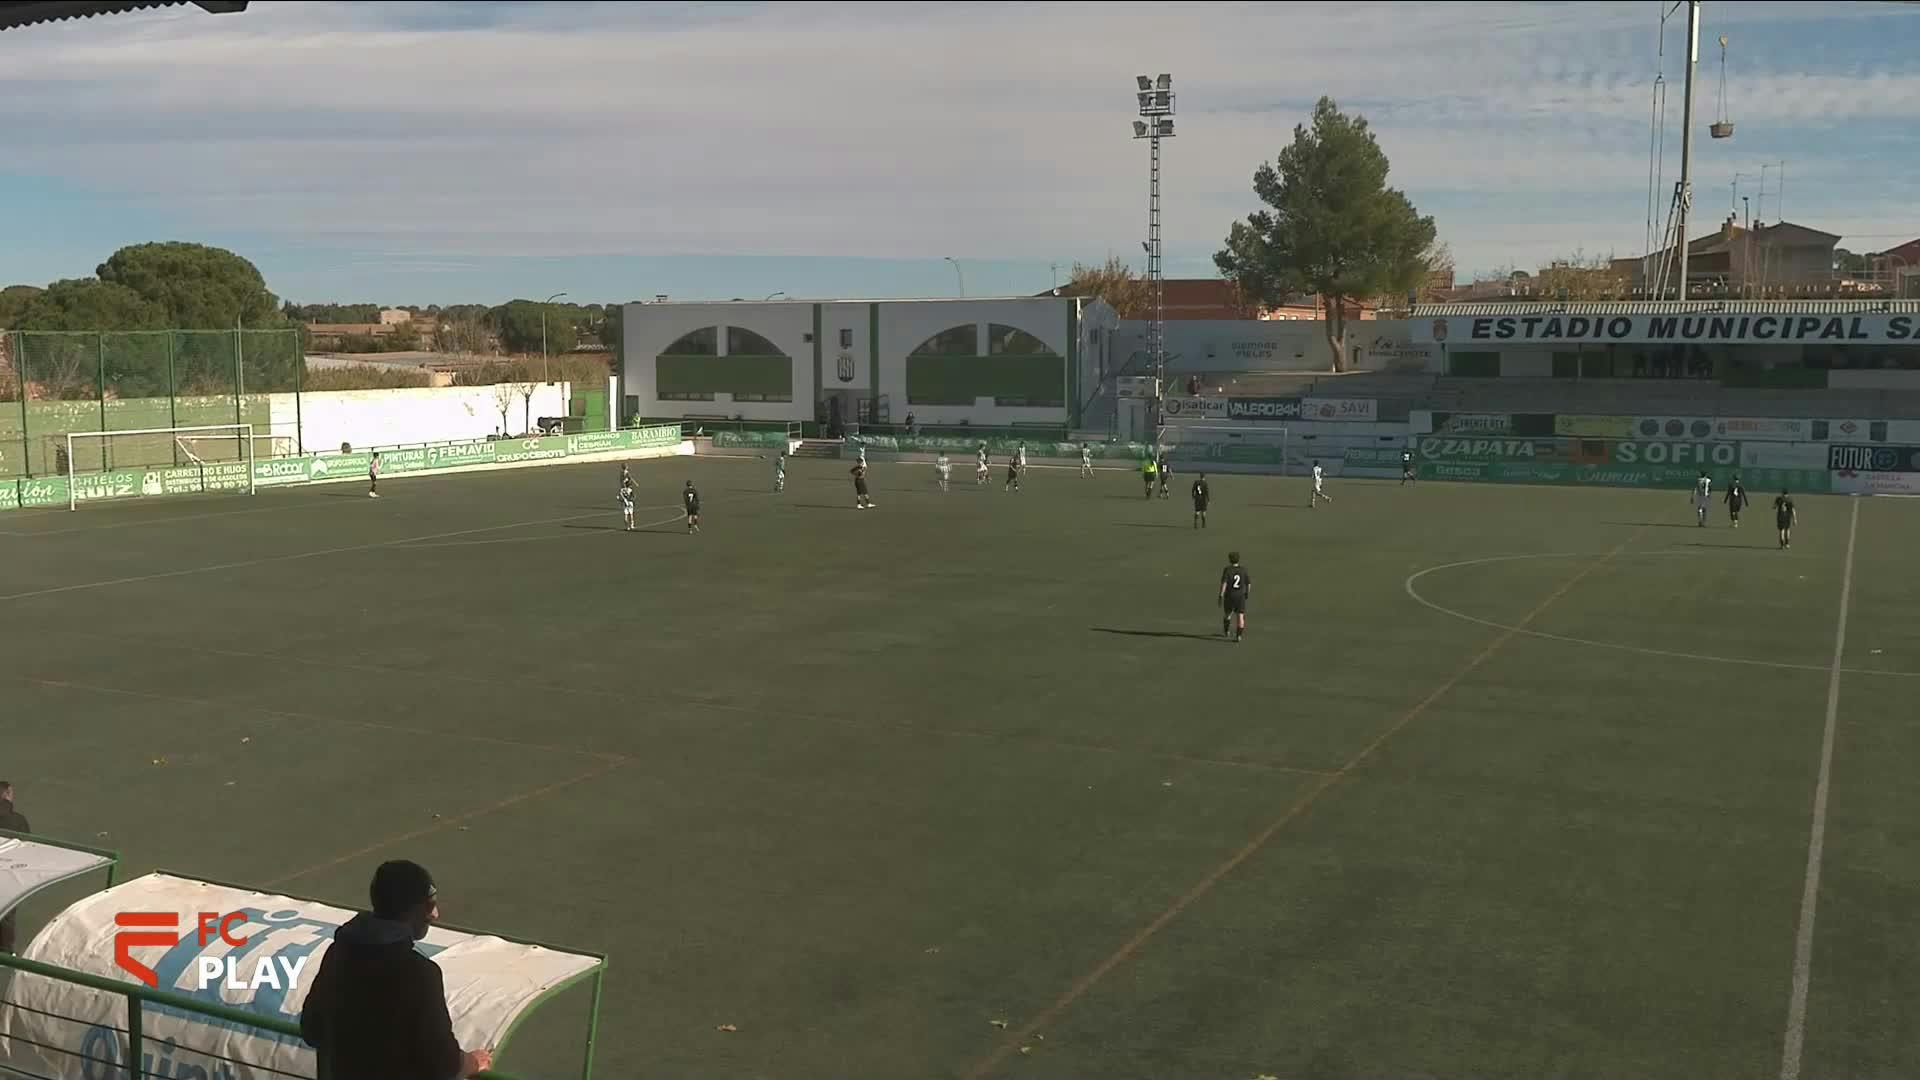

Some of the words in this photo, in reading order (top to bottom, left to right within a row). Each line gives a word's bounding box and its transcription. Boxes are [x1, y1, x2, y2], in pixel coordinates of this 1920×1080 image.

[1472, 317, 1633, 339] ESTADIO
[1648, 317, 1869, 340] MUNICIPAL
[384, 450, 425, 464] PINTURAS
[497, 451, 529, 462] GRUPO
[1441, 439, 1535, 457] ZAPATA
[1616, 441, 1735, 464] SOFIO
[1831, 446, 1873, 470] FUTUR
[1233, 574, 1241, 588] 2
